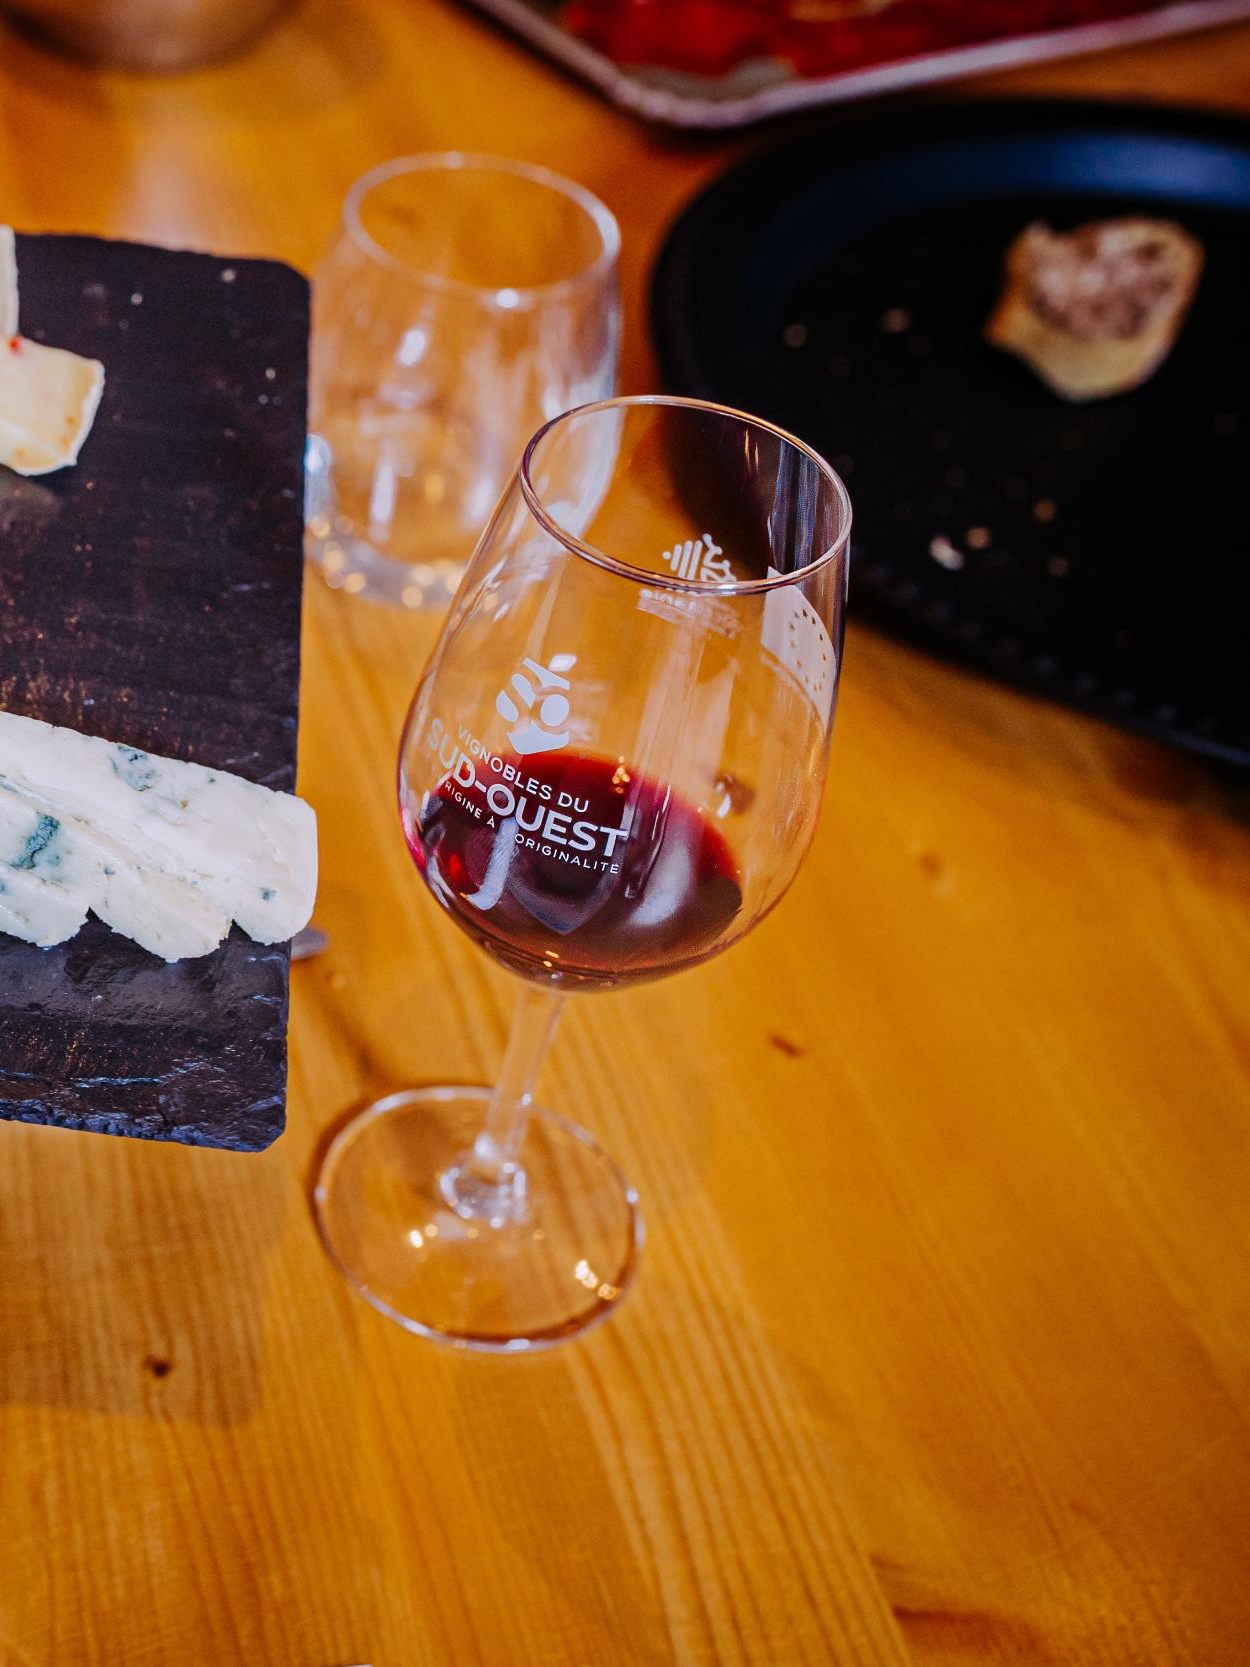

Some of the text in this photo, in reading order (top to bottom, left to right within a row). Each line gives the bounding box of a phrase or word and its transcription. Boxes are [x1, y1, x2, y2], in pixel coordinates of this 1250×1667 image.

[427, 718, 628, 858] SUD-OUEST
[443, 779, 483, 820] RIGINE
[457, 721, 590, 814] VIGNOBLES DU
